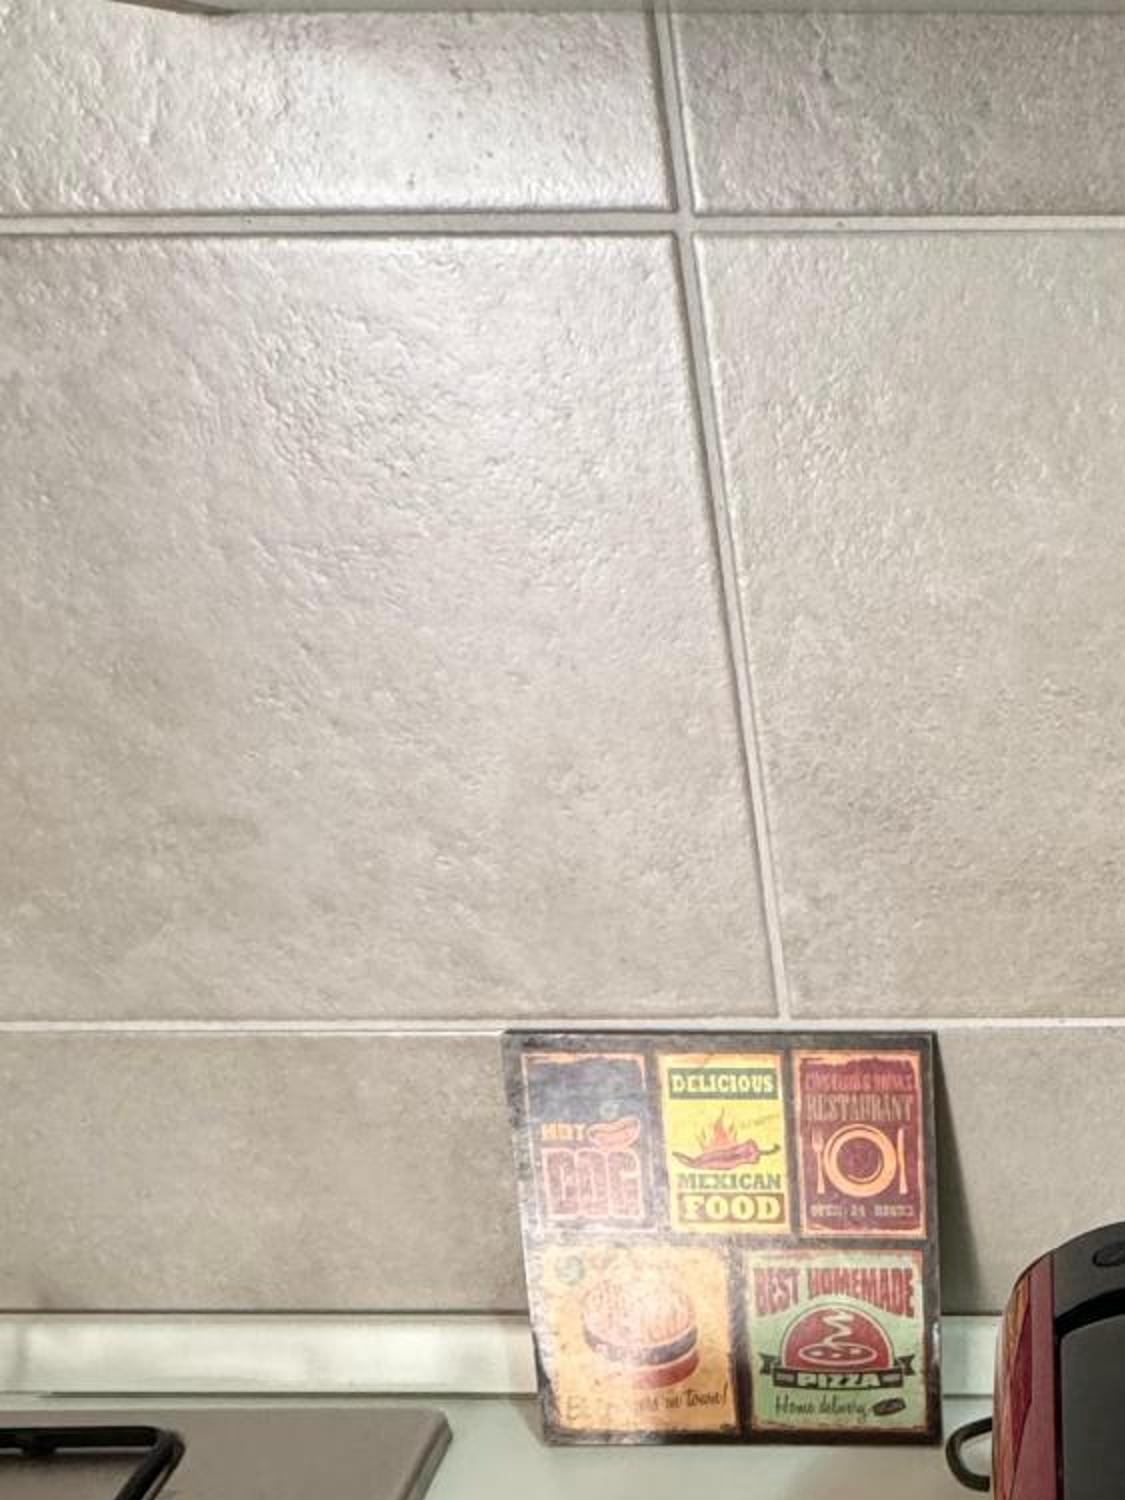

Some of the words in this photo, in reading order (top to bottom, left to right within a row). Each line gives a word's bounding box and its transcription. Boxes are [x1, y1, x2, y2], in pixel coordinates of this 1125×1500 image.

[671, 1073, 774, 1094] DELICIOUS
[676, 1173, 782, 1191] MEXICAN
[682, 1195, 782, 1221] FOOD
[753, 1267, 799, 1317] BEST
[808, 1267, 915, 1318] HOMEMADE
[796, 1373, 882, 1389] PIZZA
